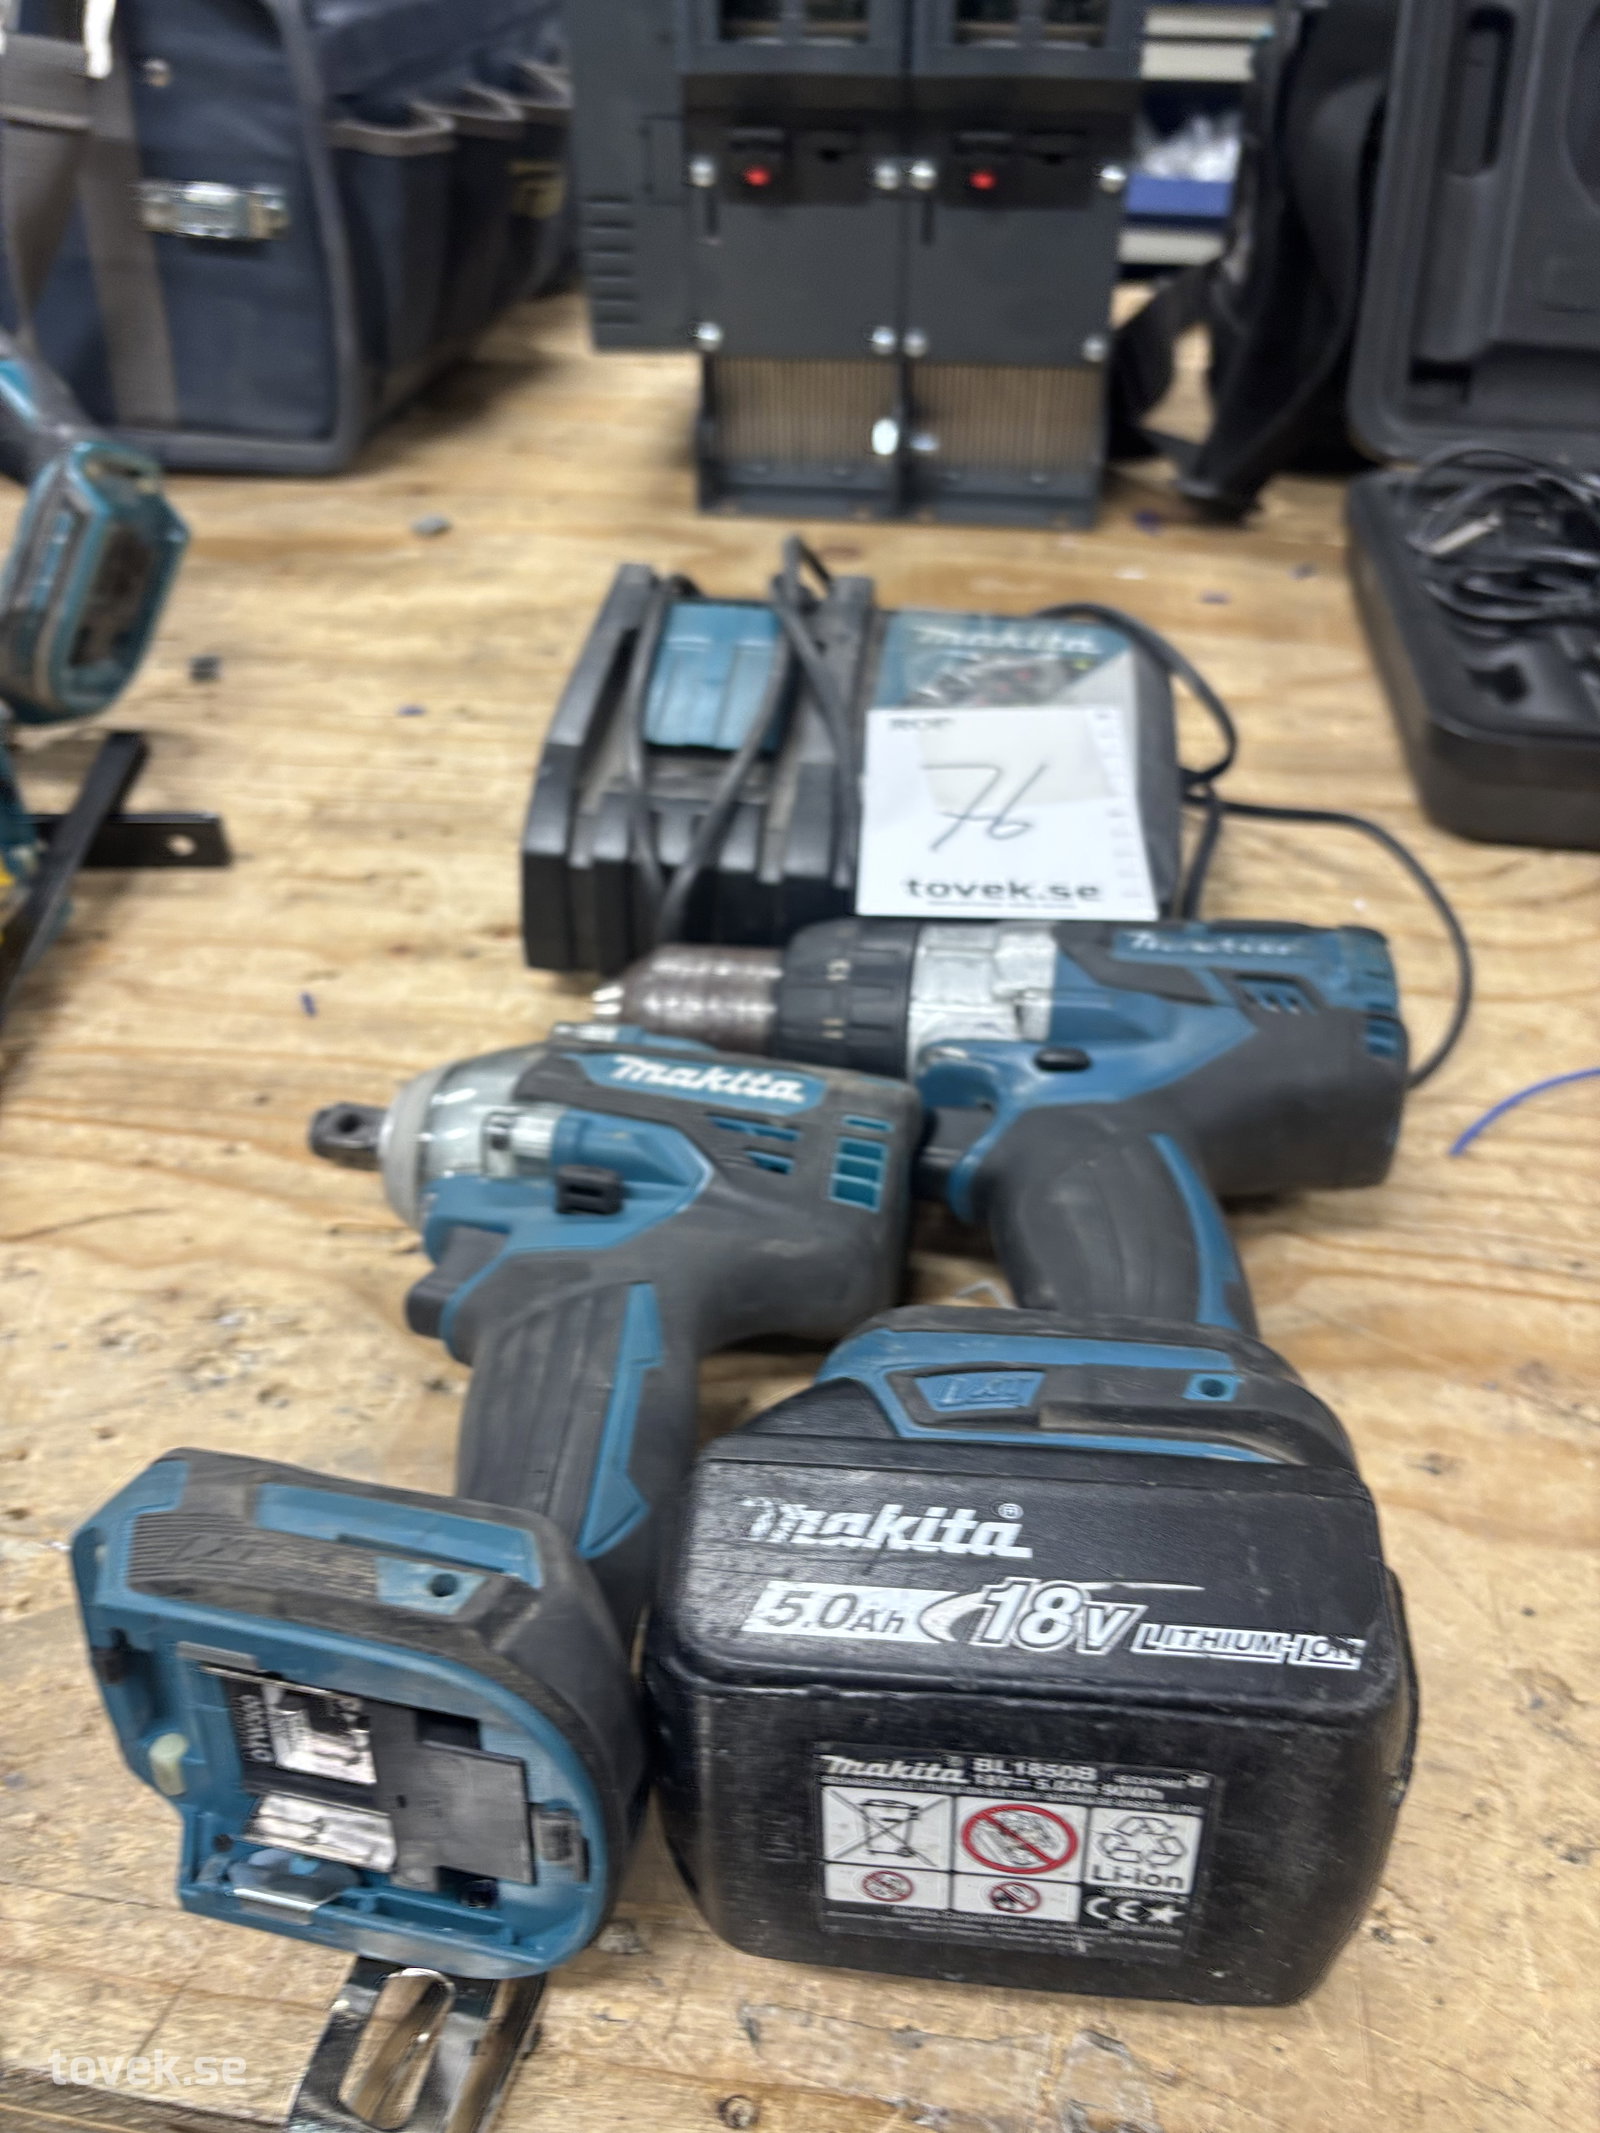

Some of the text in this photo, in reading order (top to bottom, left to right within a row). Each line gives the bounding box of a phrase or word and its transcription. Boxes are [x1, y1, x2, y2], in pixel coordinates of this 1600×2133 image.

[919, 761, 1050, 852] 76
[907, 878, 1102, 901] tovek.se
[762, 1590, 905, 1634] 5.0Ah
[1092, 1864, 1184, 1890] Li-ion
[1084, 1896, 1142, 1924] CE
